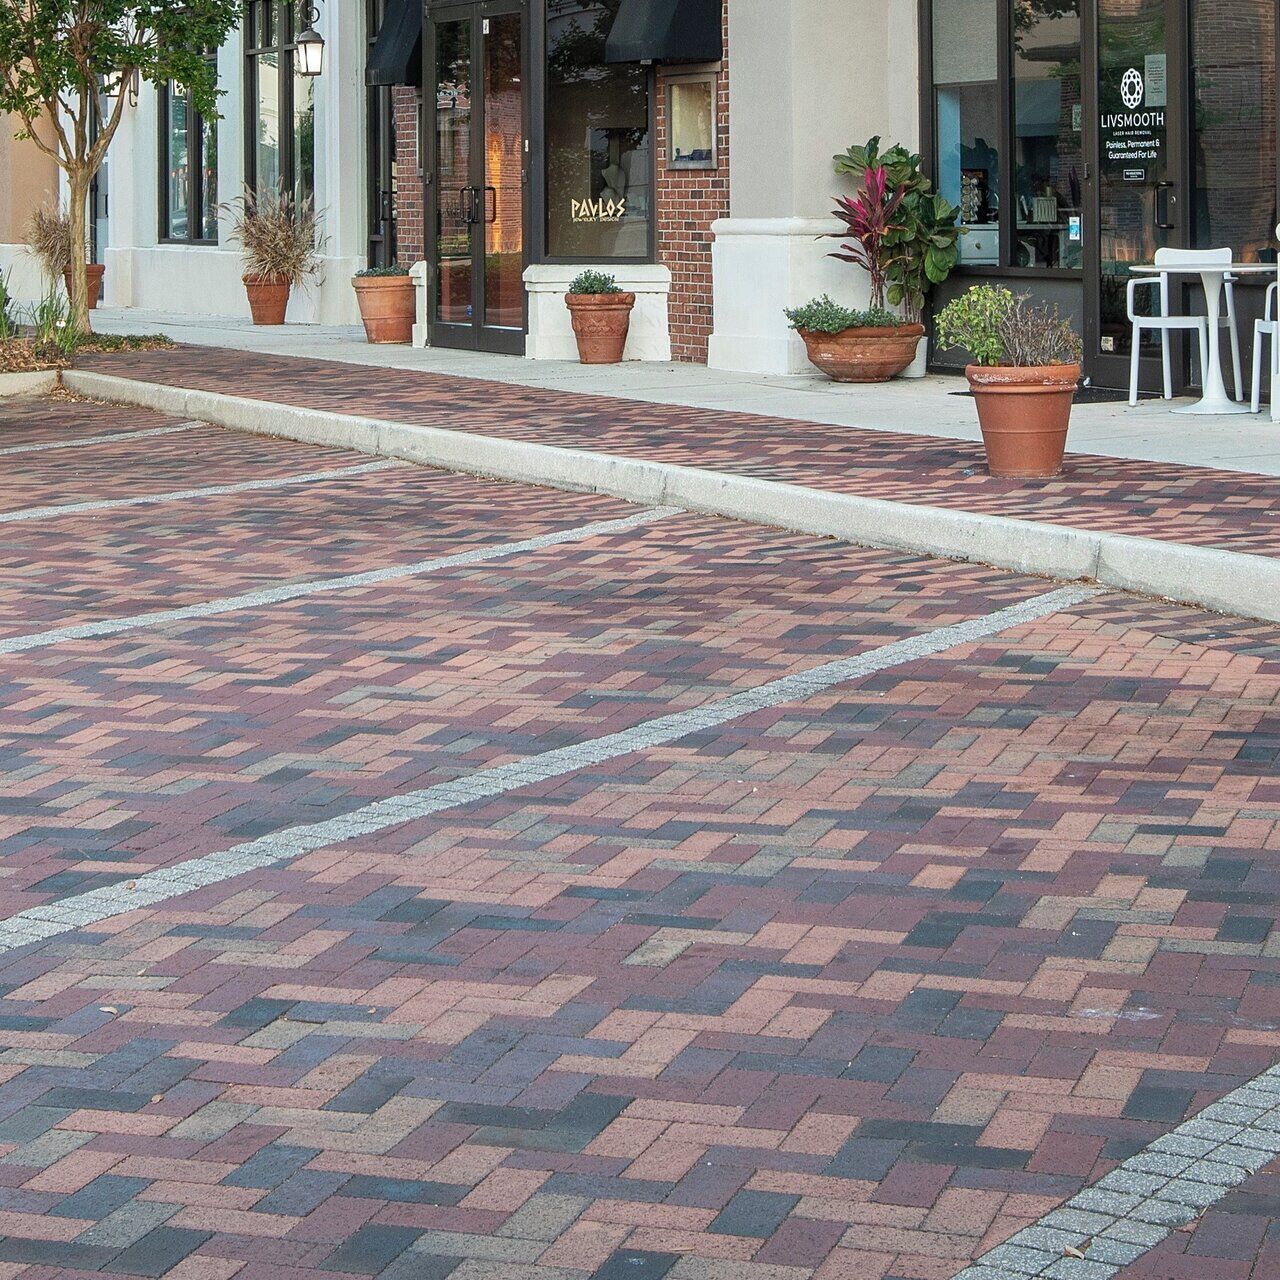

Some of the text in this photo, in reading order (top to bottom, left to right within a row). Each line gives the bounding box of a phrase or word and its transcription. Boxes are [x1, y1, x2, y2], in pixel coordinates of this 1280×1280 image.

[1101, 112, 1164, 127] LIVSMOOTH
[1128, 139, 1155, 148] Permanent
[1108, 151, 1138, 159] Guaranteed
[571, 198, 626, 218] PAVLOS
